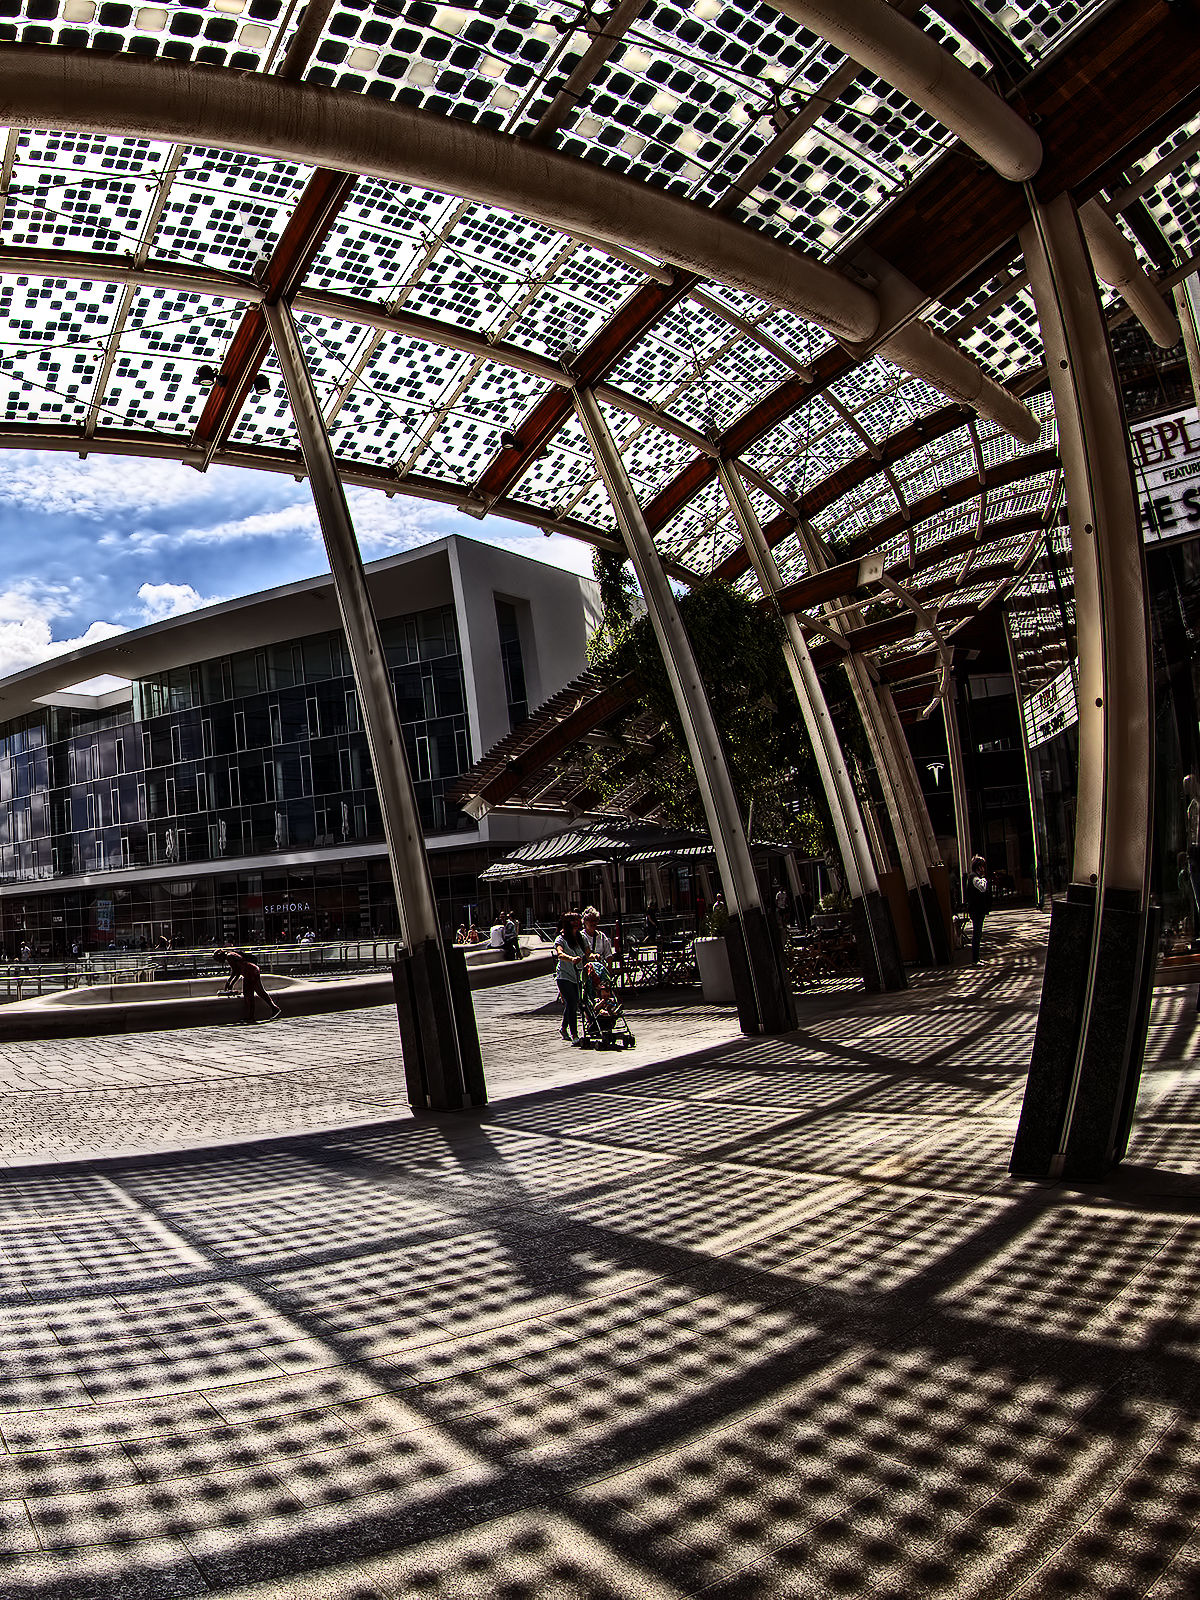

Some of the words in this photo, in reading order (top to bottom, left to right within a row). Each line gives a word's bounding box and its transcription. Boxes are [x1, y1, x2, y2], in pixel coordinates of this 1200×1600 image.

[1133, 417, 1200, 467] EPL
[1183, 487, 1200, 521] S
[264, 902, 310, 914] SEPHORA
